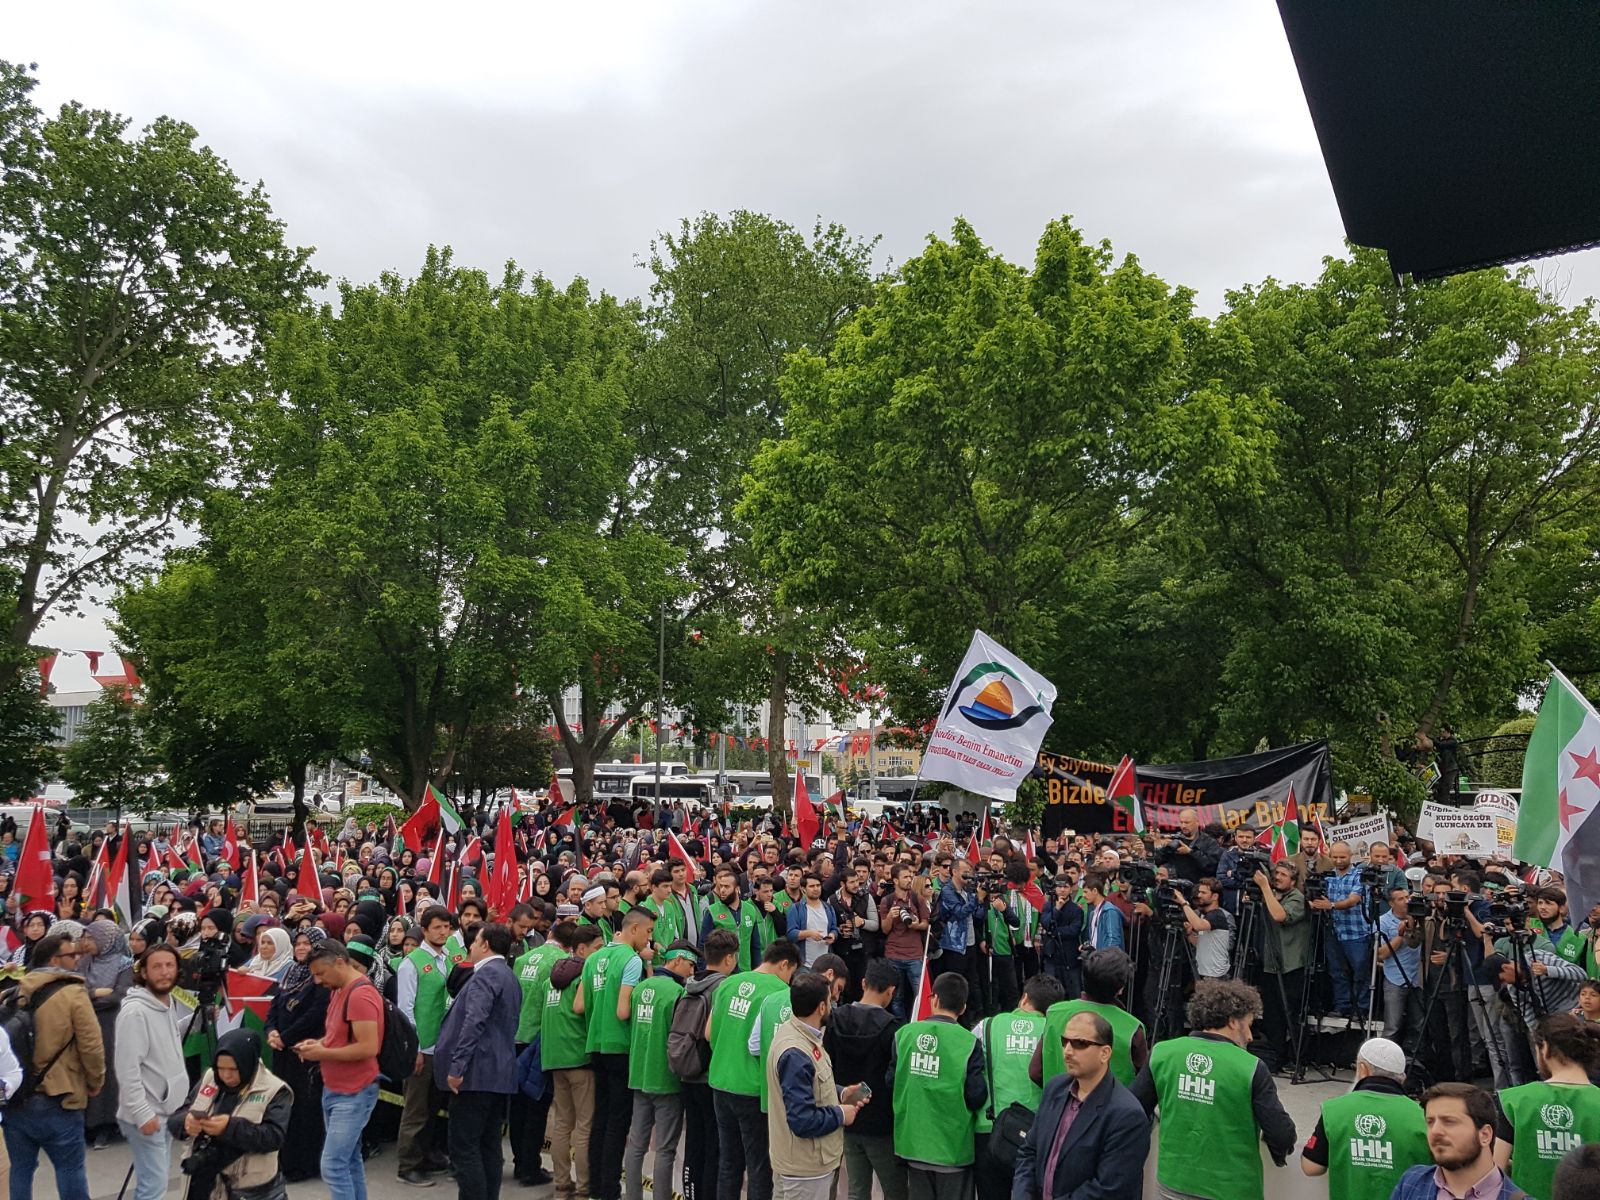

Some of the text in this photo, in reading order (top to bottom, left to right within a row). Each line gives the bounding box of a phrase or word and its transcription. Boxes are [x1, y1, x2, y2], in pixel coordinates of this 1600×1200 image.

[956, 735, 982, 752] Benim
[982, 744, 1023, 768] Emanetim
[1039, 753, 1055, 774] Ey
[1060, 756, 1118, 774] Siyonis
[1049, 778, 1106, 805] Bizde
[1332, 817, 1383, 835] KUDÜS ÖZGÜR
[1463, 813, 1491, 821] ÖZGÜR
[1332, 823, 1385, 842] OLUNCAYA DEK
